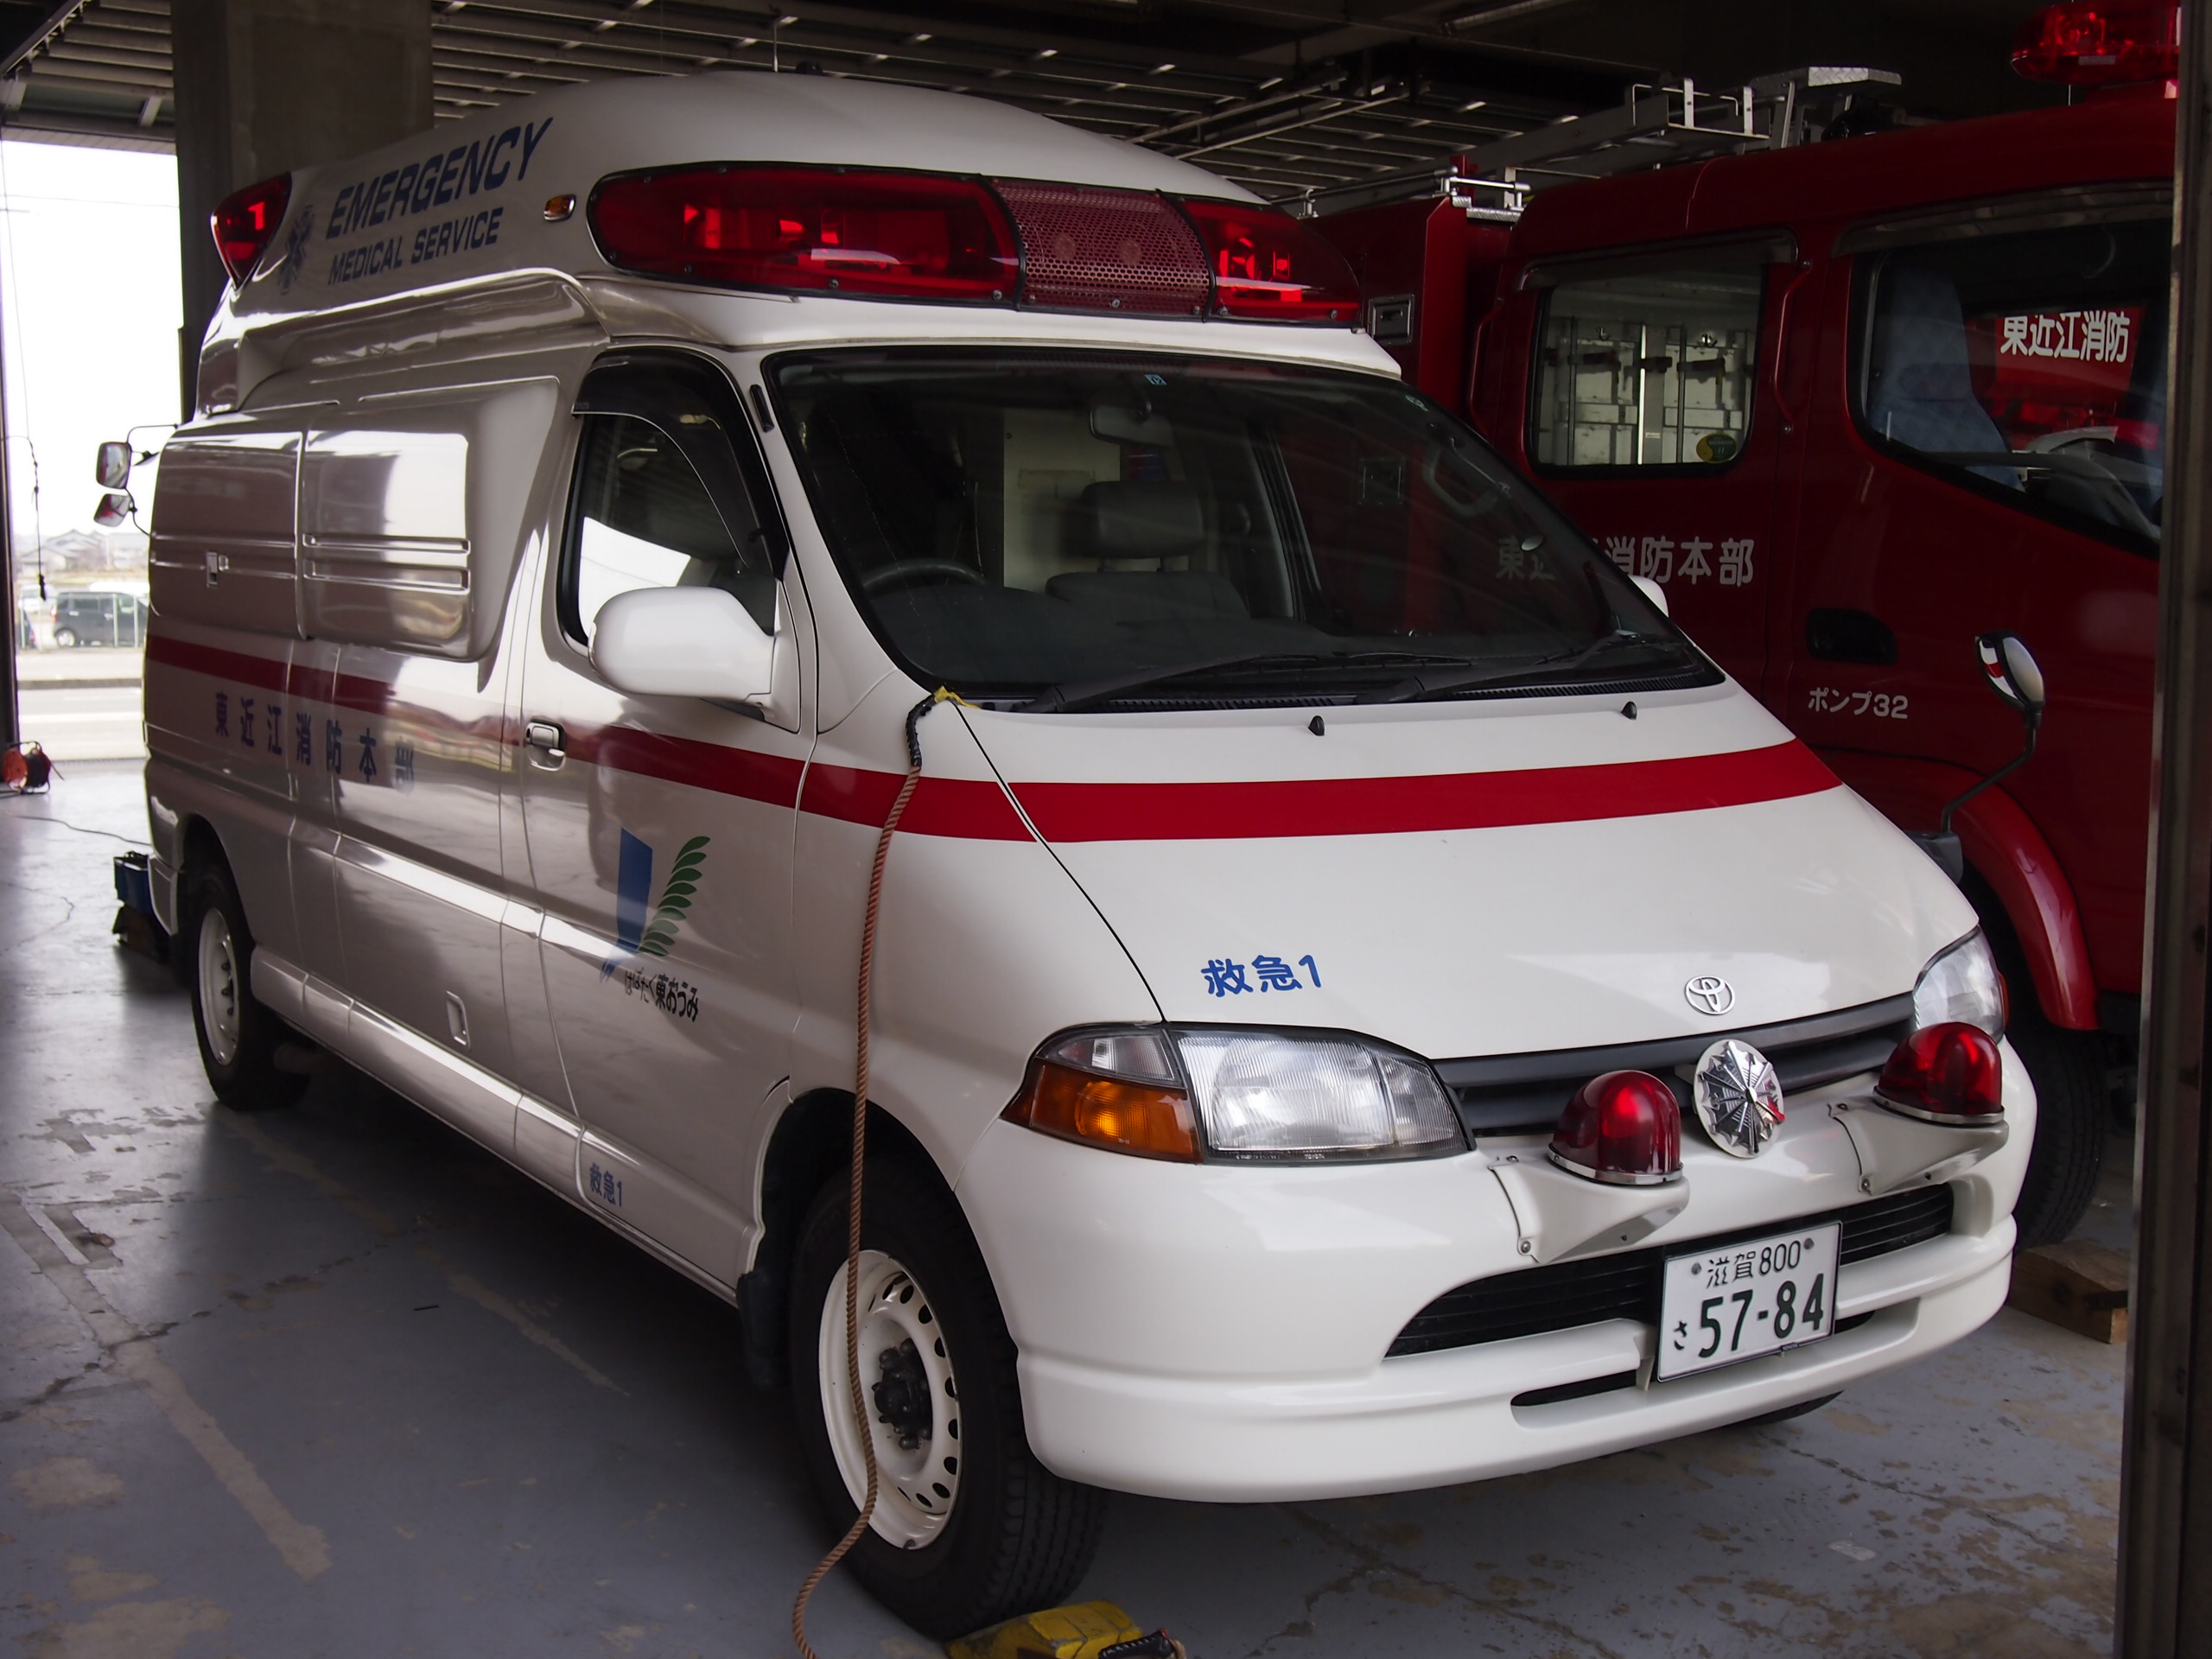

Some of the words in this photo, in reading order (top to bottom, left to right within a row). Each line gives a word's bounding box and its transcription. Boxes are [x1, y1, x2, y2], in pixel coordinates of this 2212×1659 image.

[326, 118, 553, 239] EMERGENCY
[327, 236, 404, 285] MEDICAL
[410, 207, 504, 264] SERVICE
[2000, 310, 2130, 363] 東近江消防
[1808, 687, 1909, 720] ポンプ32
[215, 692, 415, 792] 東近江消防本部
[1201, 955, 1321, 997] 救急1
[589, 1162, 622, 1207] 救急1
[1699, 1273, 1824, 1358] 57-84
